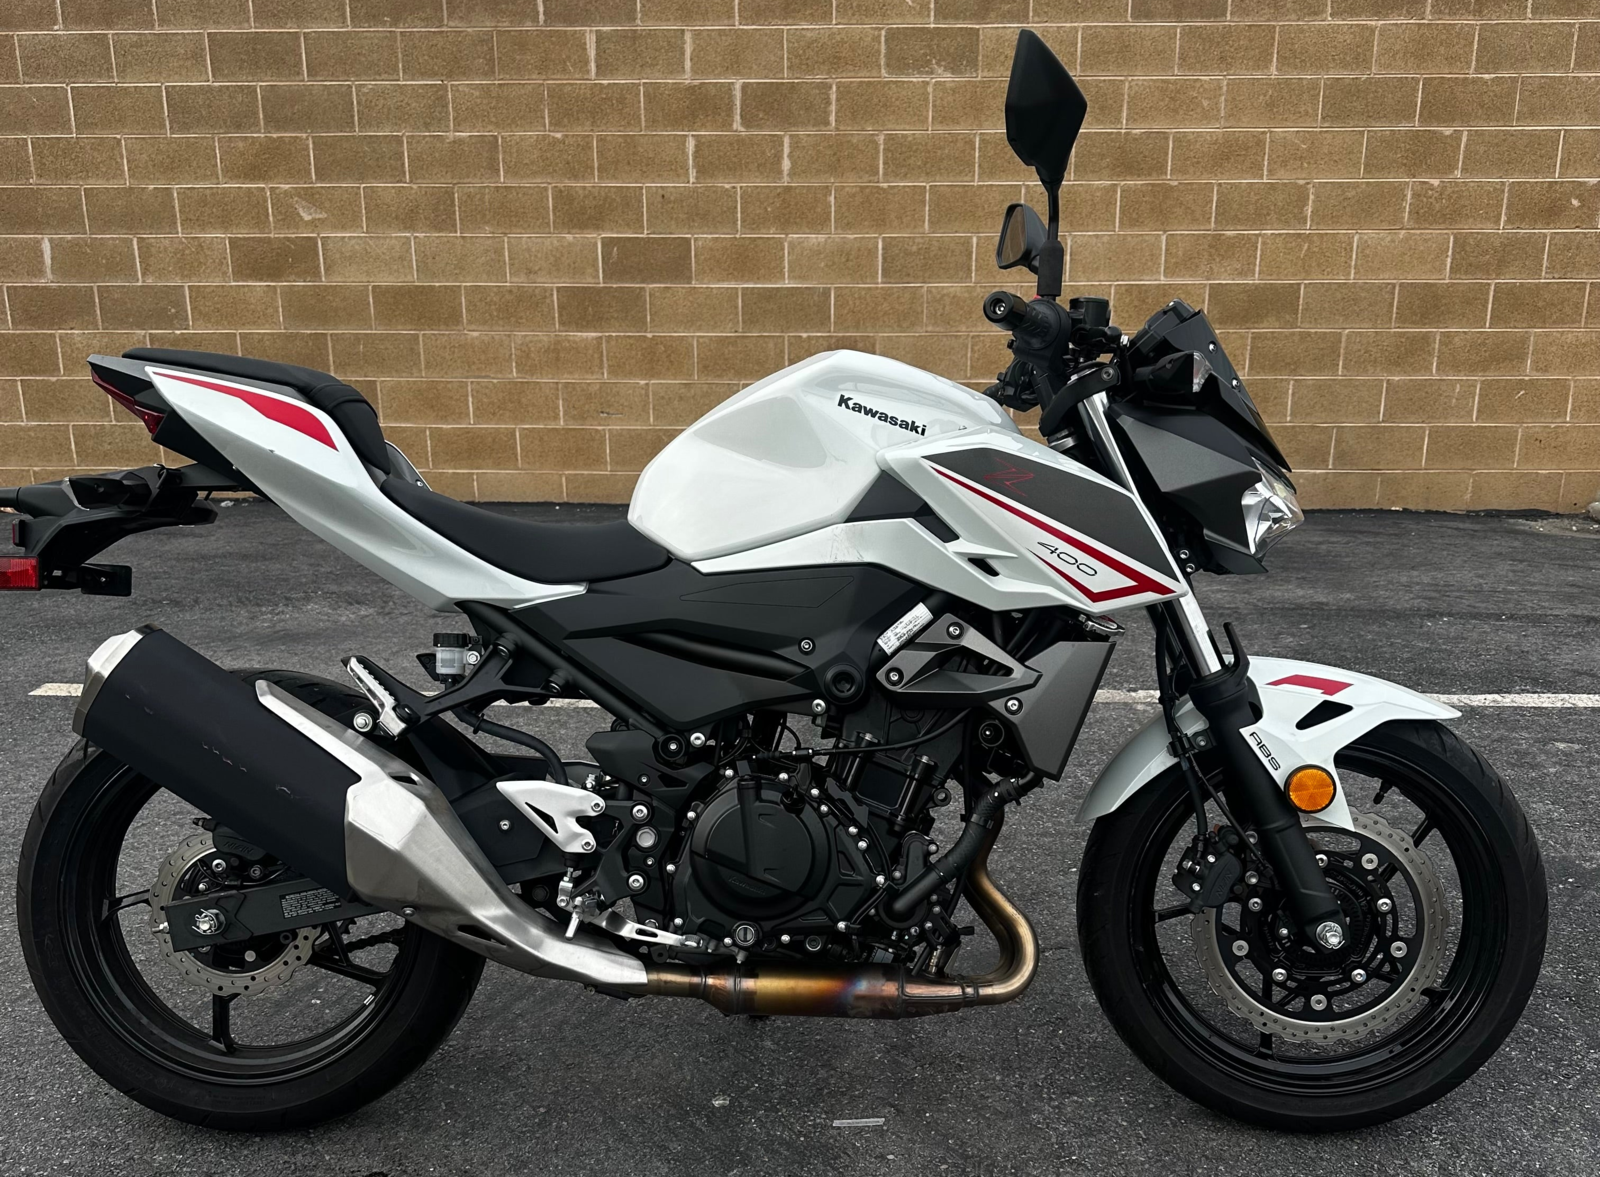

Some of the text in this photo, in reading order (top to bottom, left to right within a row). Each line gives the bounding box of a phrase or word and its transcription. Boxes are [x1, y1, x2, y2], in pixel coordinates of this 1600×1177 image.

[837, 394, 927, 437] Kawasaki
[1037, 541, 1098, 577] 400
[1249, 731, 1281, 771] ABS
